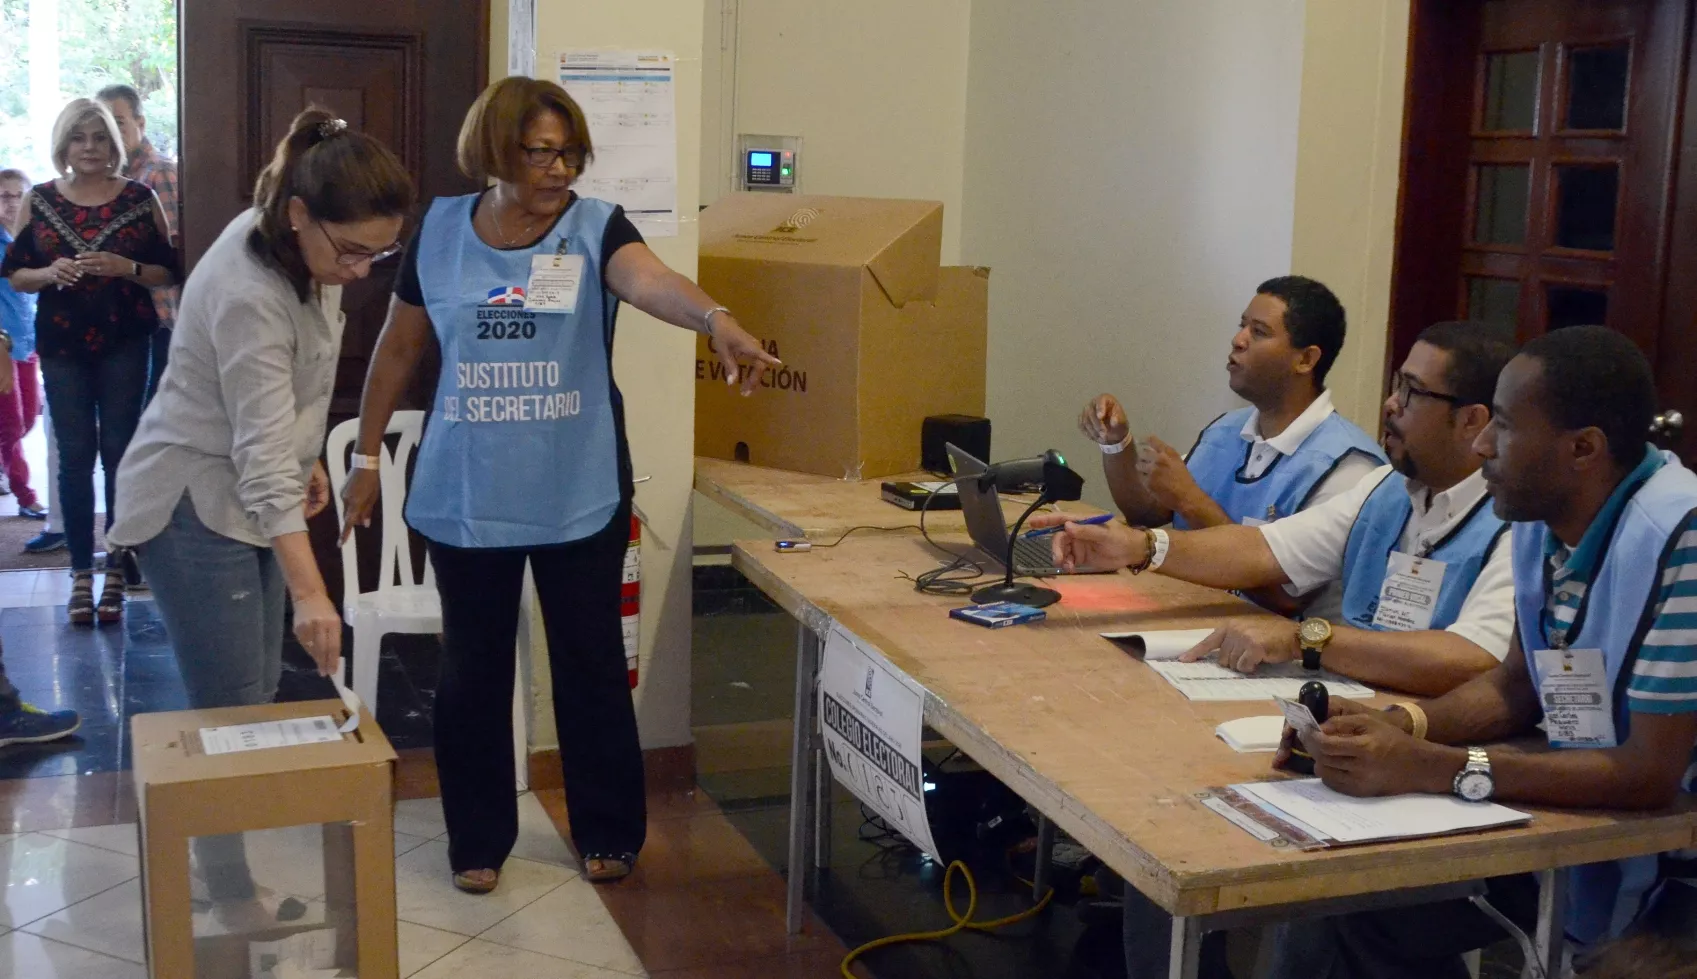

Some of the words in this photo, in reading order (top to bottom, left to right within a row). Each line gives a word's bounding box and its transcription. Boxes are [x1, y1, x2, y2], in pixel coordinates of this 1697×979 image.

[476, 309, 536, 320] ELECCIONES
[476, 320, 537, 340] 2020
[456, 361, 559, 389] SUSTITUTO
[466, 390, 581, 422] SECRETARIO
[825, 696, 861, 749] COLEGIO
[862, 726, 921, 799] ELECTORAL
